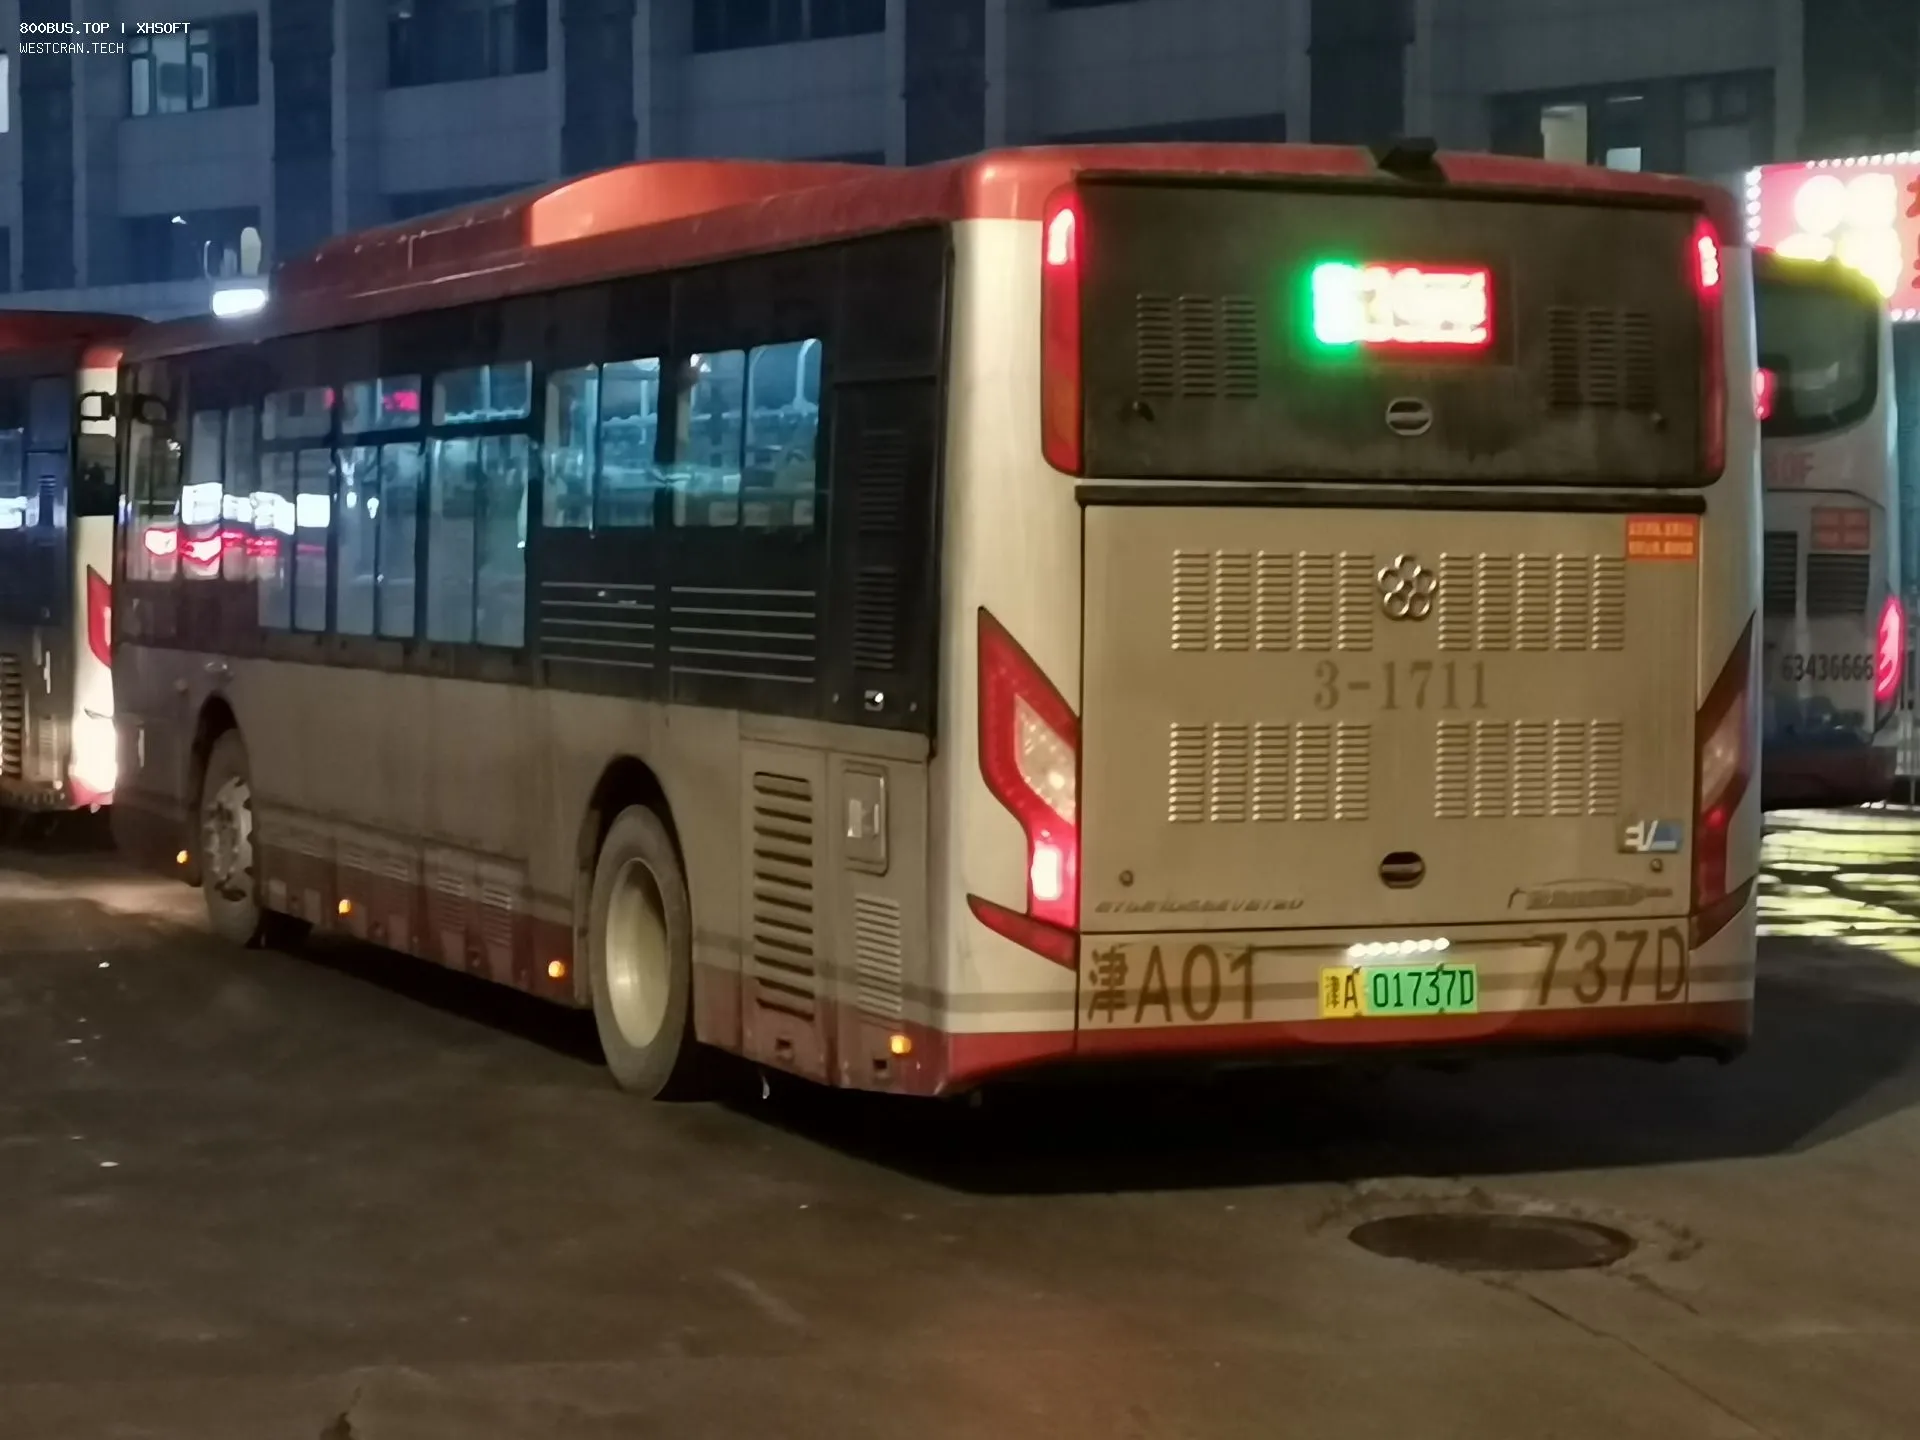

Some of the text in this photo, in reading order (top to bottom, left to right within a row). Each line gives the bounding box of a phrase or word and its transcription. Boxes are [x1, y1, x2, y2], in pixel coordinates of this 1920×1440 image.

[1313, 659, 1488, 711] 3-1711
[1782, 653, 1875, 681] 63436666
[1531, 926, 1686, 1006] 737D
